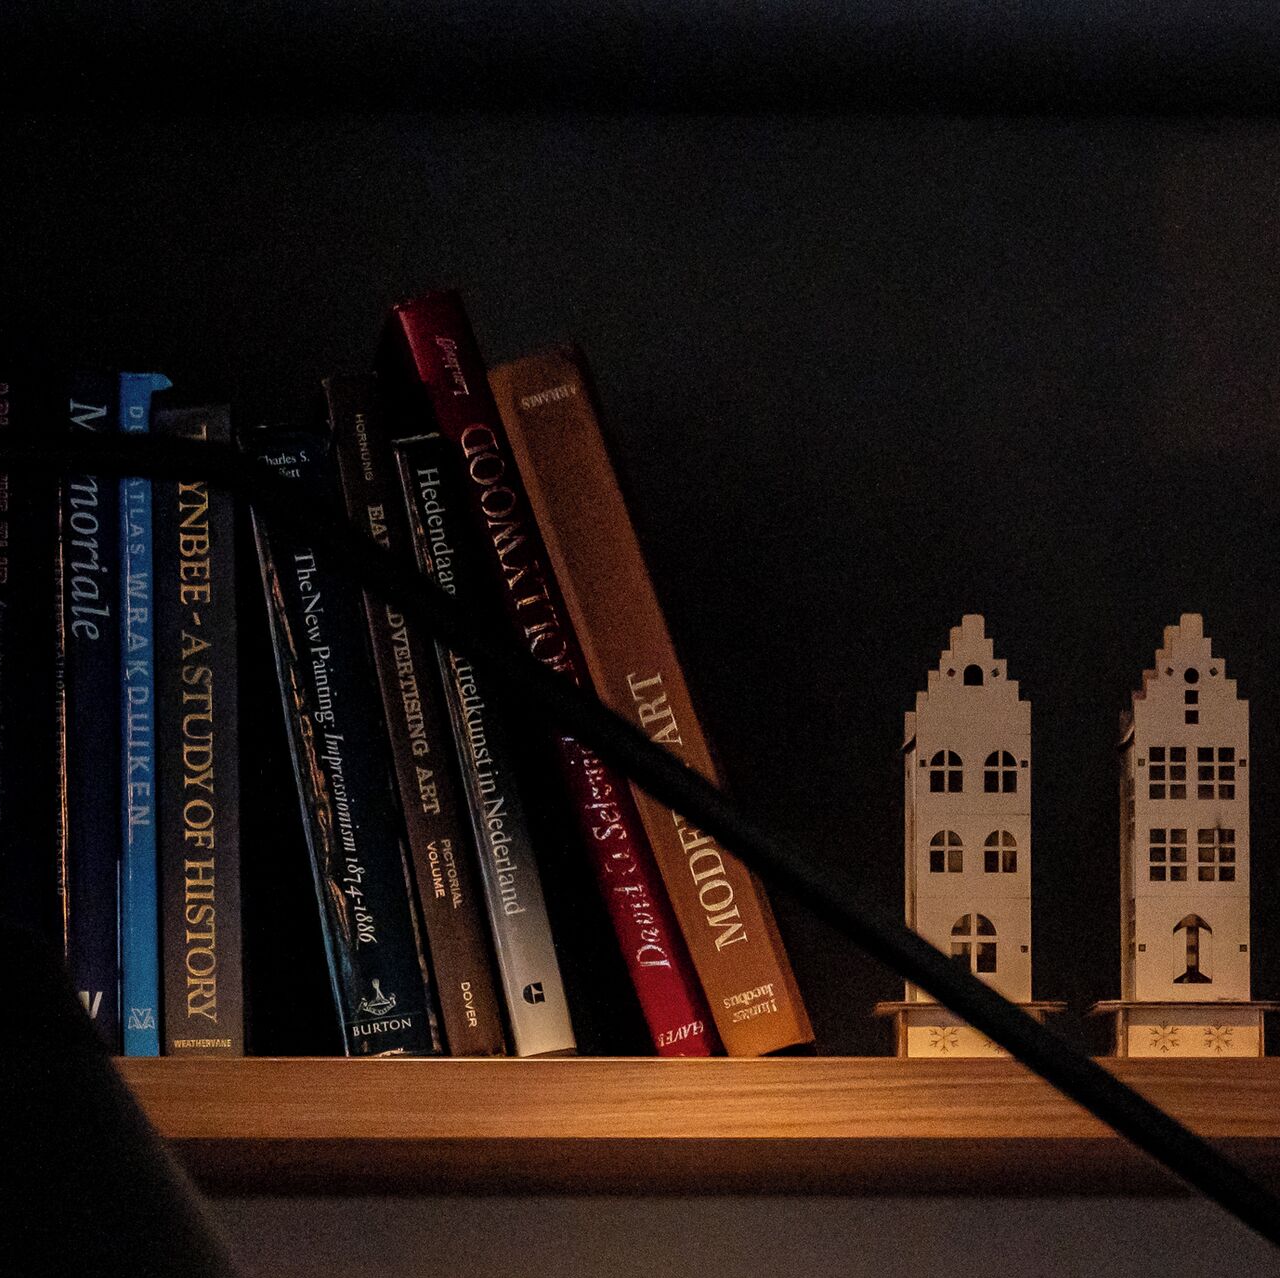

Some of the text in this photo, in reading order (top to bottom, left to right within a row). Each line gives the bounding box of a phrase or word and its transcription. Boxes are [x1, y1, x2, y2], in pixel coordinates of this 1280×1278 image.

[355, 413, 374, 482] HORNUNG
[302, 592, 325, 643] New
[125, 568, 151, 825] WRAKDUIKEN
[310, 644, 337, 729] Painting:
[386, 603, 442, 815] DVERTISING ART
[626, 671, 683, 747] ART
[182, 665, 214, 793] STUDY
[183, 799, 215, 850] OF
[322, 732, 361, 858] Impressionism
[426, 841, 446, 899] VOLUME
[440, 838, 463, 909] PICTORIAL
[483, 796, 527, 915] Nederland
[185, 857, 218, 1024] HISTORY
[342, 855, 379, 951] 1874-1886
[352, 1017, 413, 1037] BURTON
[460, 982, 478, 1028] DOVER
[173, 1038, 232, 1049] WEATHERVANE
